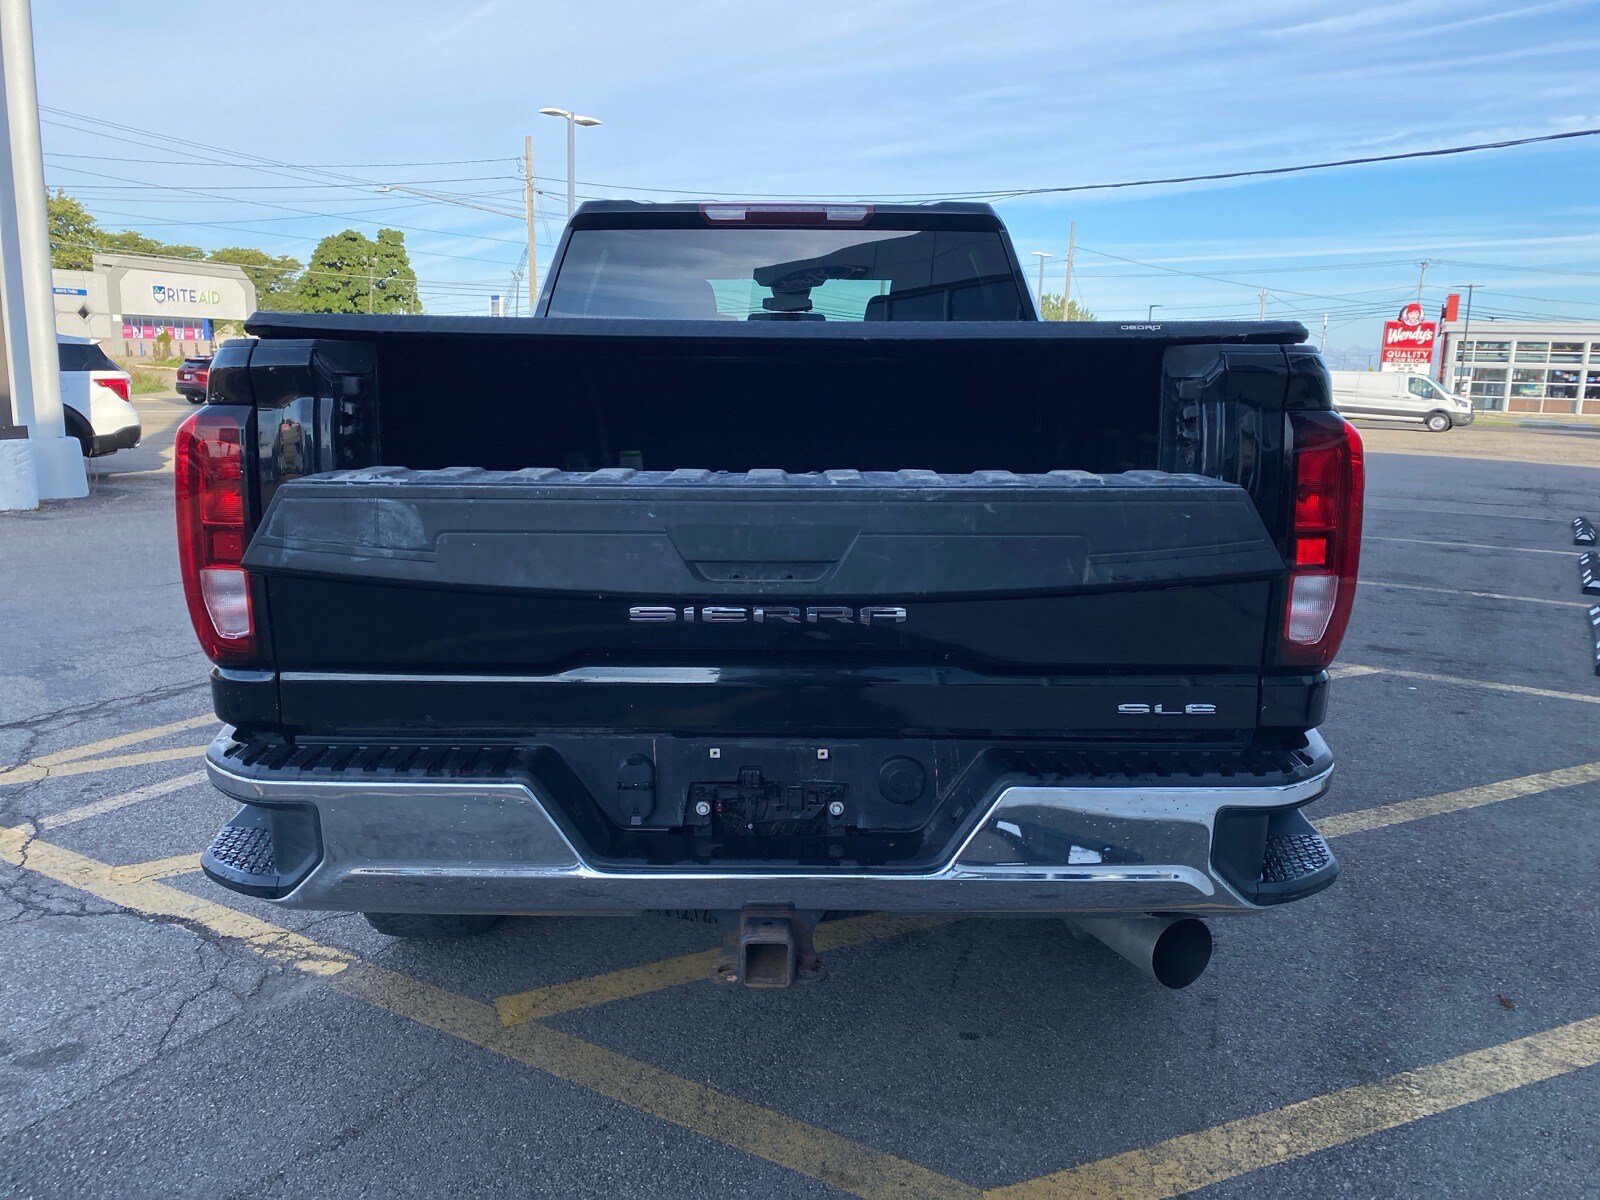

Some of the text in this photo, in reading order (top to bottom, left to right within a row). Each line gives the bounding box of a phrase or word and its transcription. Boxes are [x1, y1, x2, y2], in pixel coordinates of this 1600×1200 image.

[167, 287, 220, 304] RITE AID
[1387, 325, 1434, 345] Wendy's
[1386, 350, 1429, 358] QUALITY
[628, 606, 908, 624] SIERRA
[1117, 703, 1217, 714] SLE
